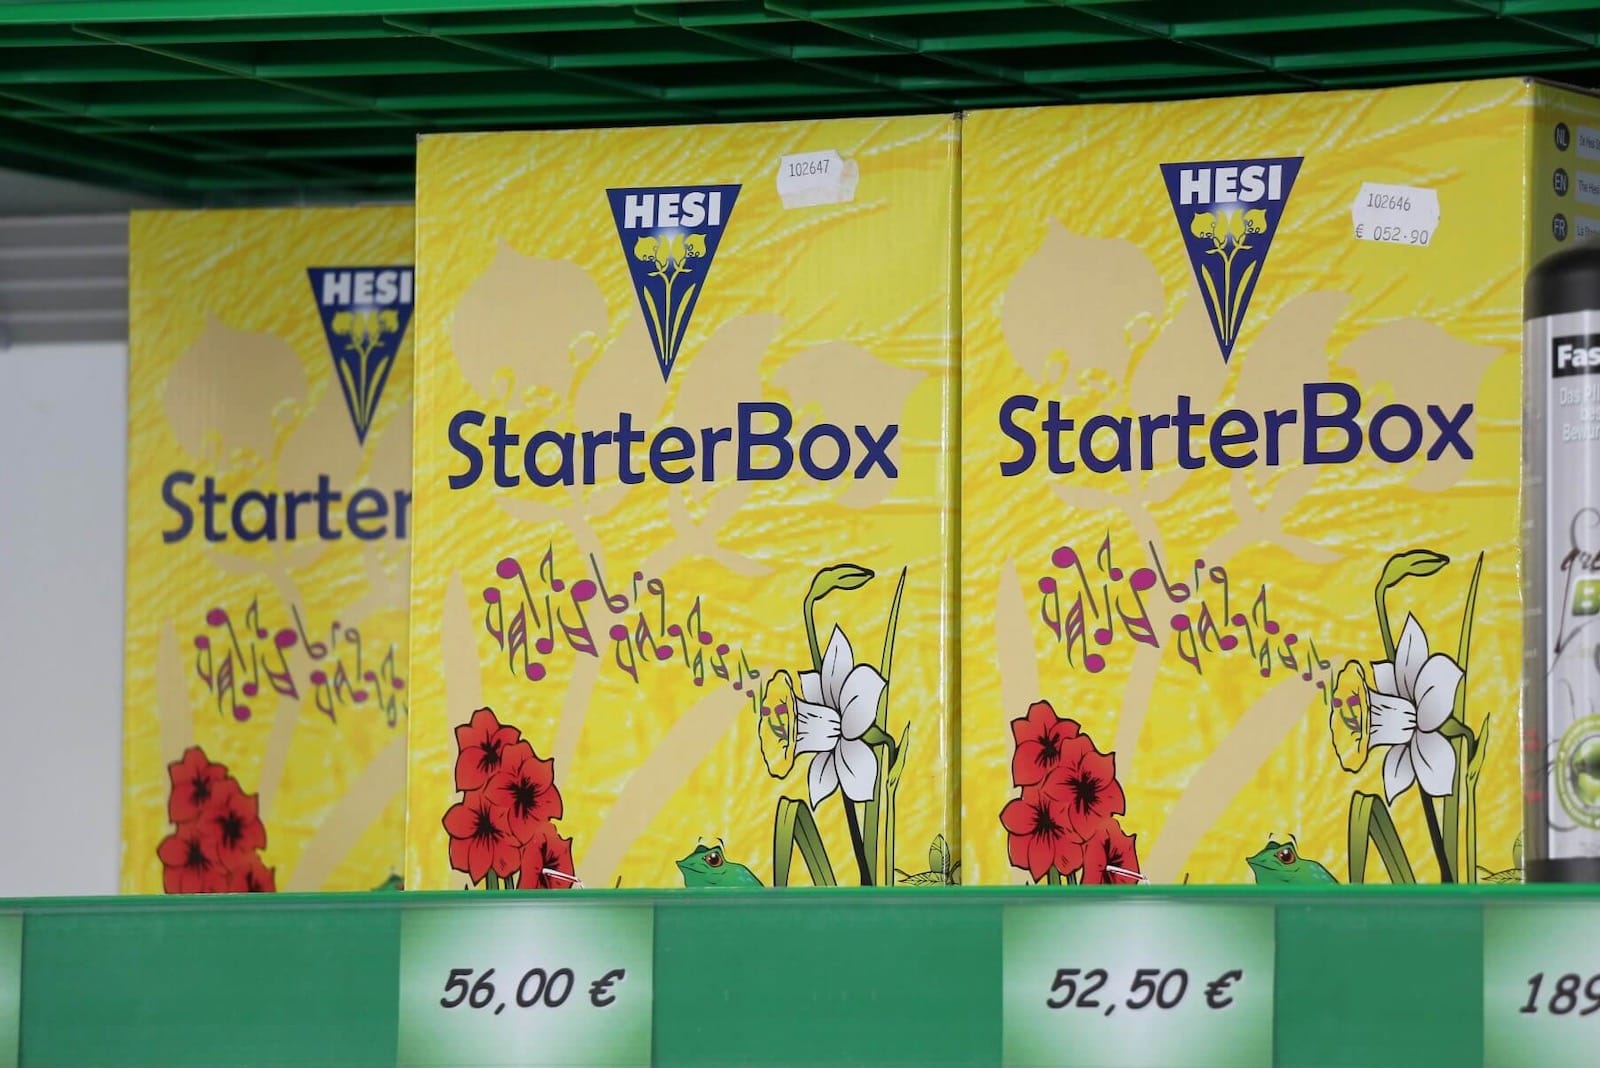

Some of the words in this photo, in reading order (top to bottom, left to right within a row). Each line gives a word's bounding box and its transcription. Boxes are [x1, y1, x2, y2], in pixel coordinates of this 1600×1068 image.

[1556, 127, 1568, 147] NL
[789, 159, 830, 177] 102647
[1179, 165, 1282, 205] HESI
[1554, 172, 1567, 192] EN
[623, 191, 721, 229] HESI
[1367, 193, 1411, 212] 102646
[1355, 223, 1364, 239] €
[1553, 217, 1566, 238] FR
[322, 270, 412, 305] HESI
[447, 401, 899, 490] StarterBox
[999, 382, 1474, 477] StarterBox
[440, 967, 574, 1016] 56,00
[588, 967, 625, 1009] €
[1046, 967, 1188, 1017] 52,50
[1204, 968, 1243, 1010] €
[1519, 972, 1600, 1016] 189
